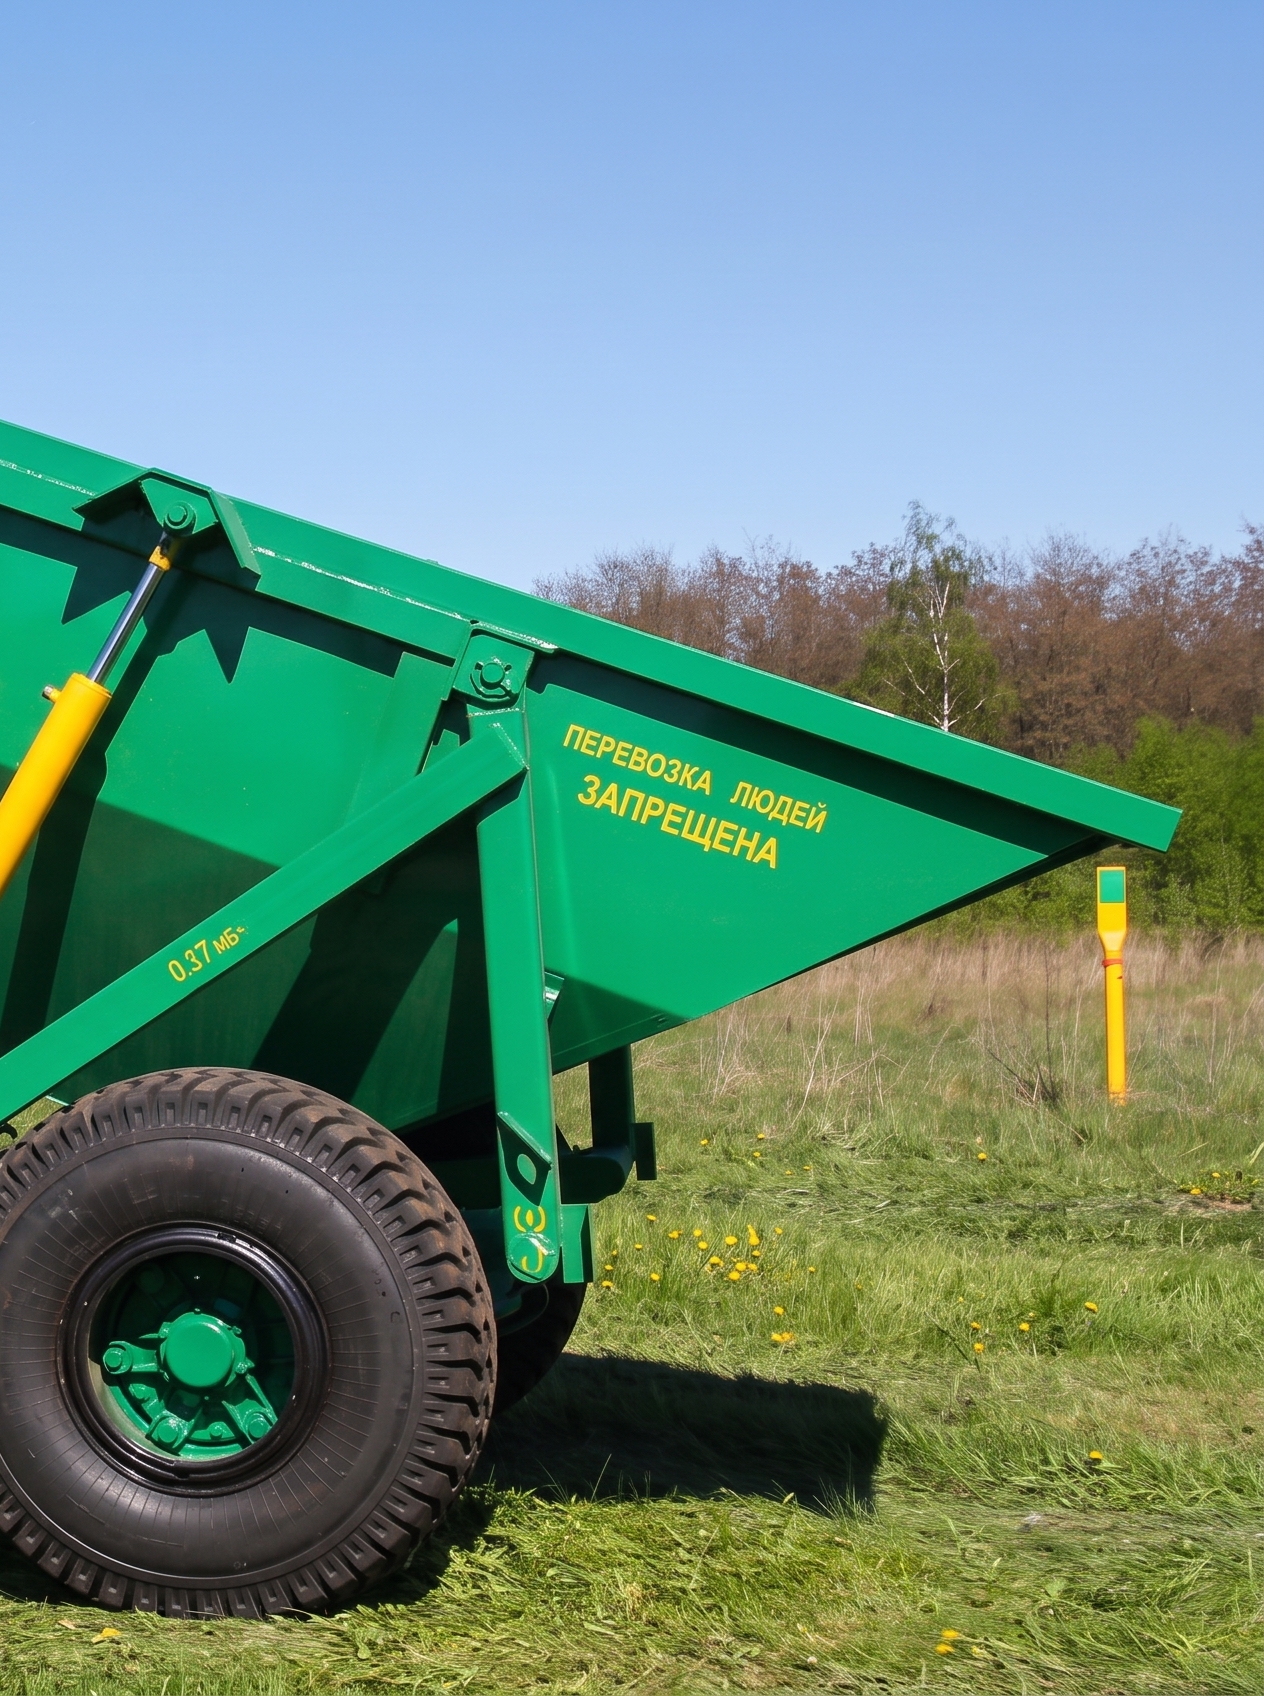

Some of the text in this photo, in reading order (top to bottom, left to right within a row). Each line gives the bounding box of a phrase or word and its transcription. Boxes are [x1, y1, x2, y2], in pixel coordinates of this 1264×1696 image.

[562, 723, 828, 834] ПЕРЕВОЗКА ЛЮДЕЙ
[577, 774, 778, 869] ЗАПРЕЩЕНА
[168, 939, 211, 982] 0.37
